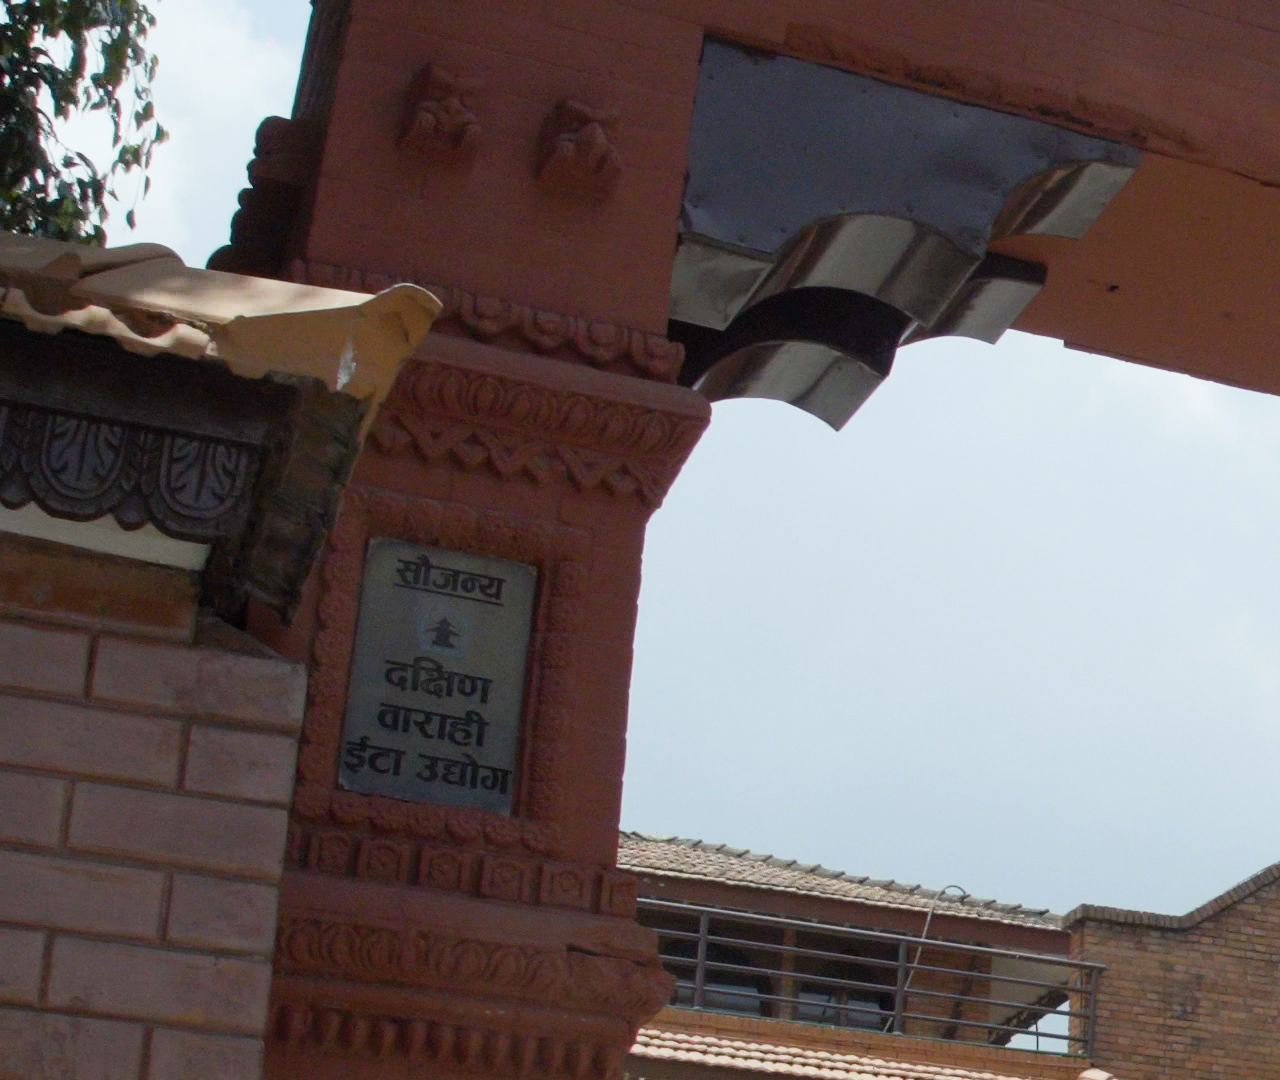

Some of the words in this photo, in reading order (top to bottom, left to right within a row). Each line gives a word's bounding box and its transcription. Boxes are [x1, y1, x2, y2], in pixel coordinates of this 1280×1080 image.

[384, 656, 493, 704] दक्षिण
[377, 702, 490, 748] वाराही
[415, 753, 512, 794] उद्योग
